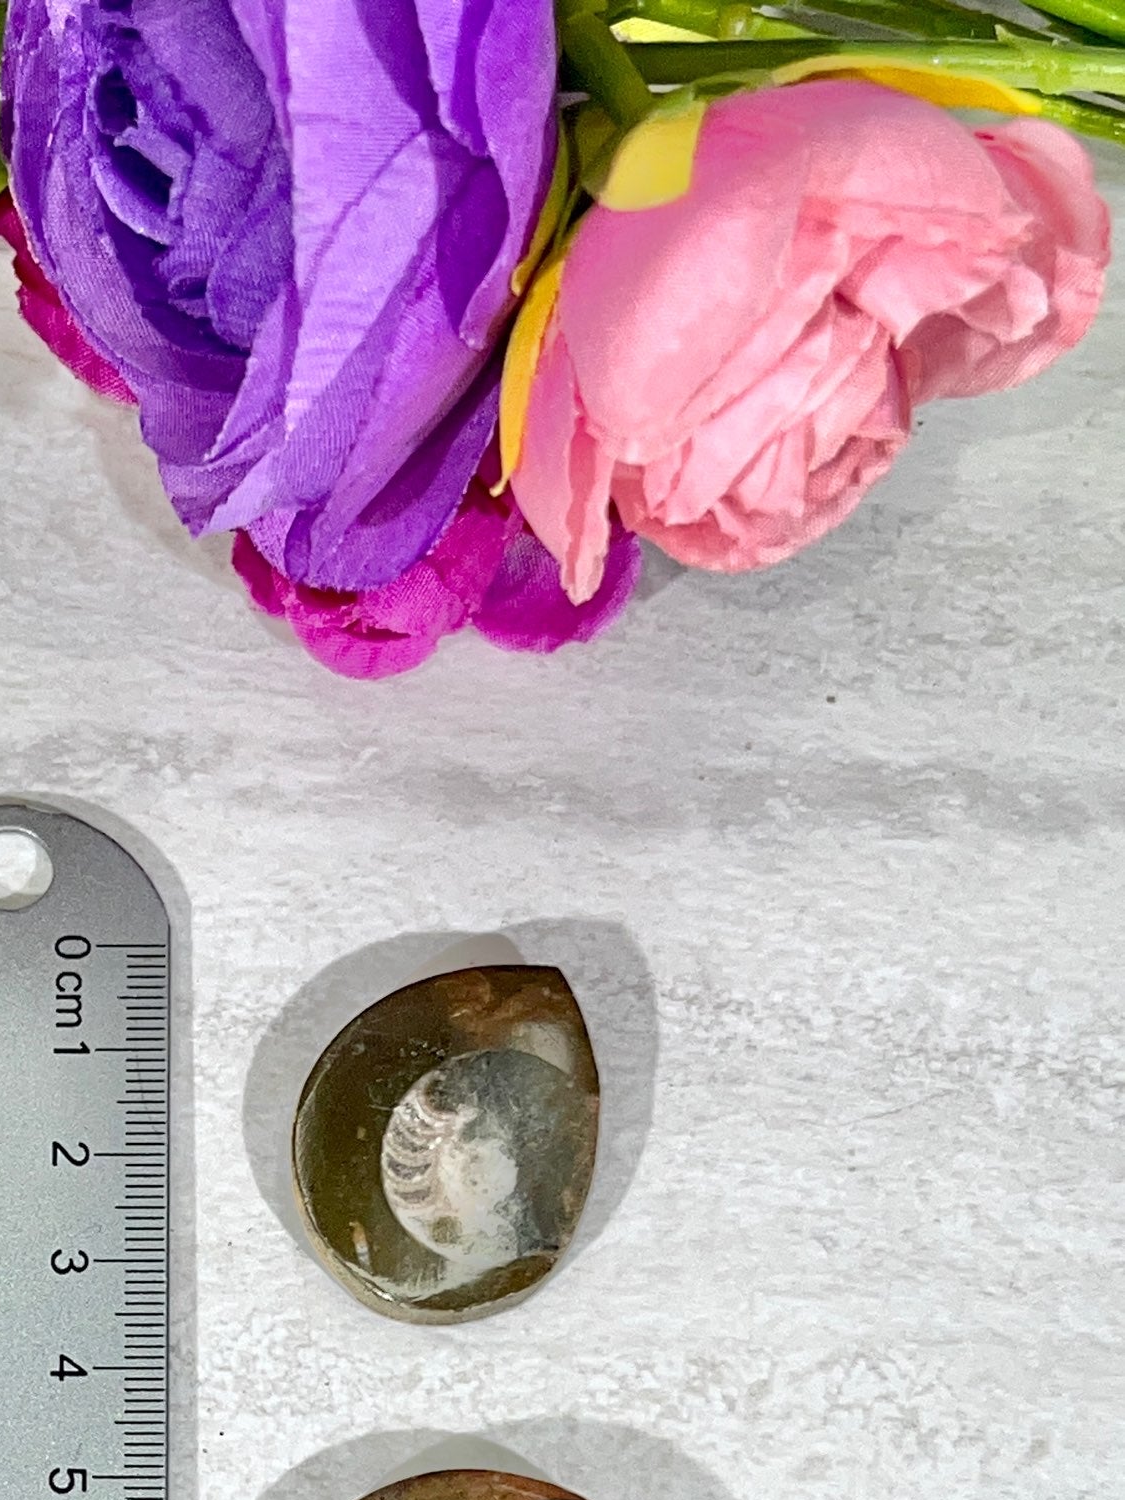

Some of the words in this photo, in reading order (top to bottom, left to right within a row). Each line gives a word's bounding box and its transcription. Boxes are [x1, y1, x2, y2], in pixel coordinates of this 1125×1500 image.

[54, 934, 92, 960] 0
[55, 971, 83, 1028] cm
[53, 1040, 91, 1055] 1
[51, 1140, 90, 1167] 2
[50, 1249, 90, 1276] 3
[49, 1353, 89, 1382] 4
[48, 1467, 88, 1495] 5
